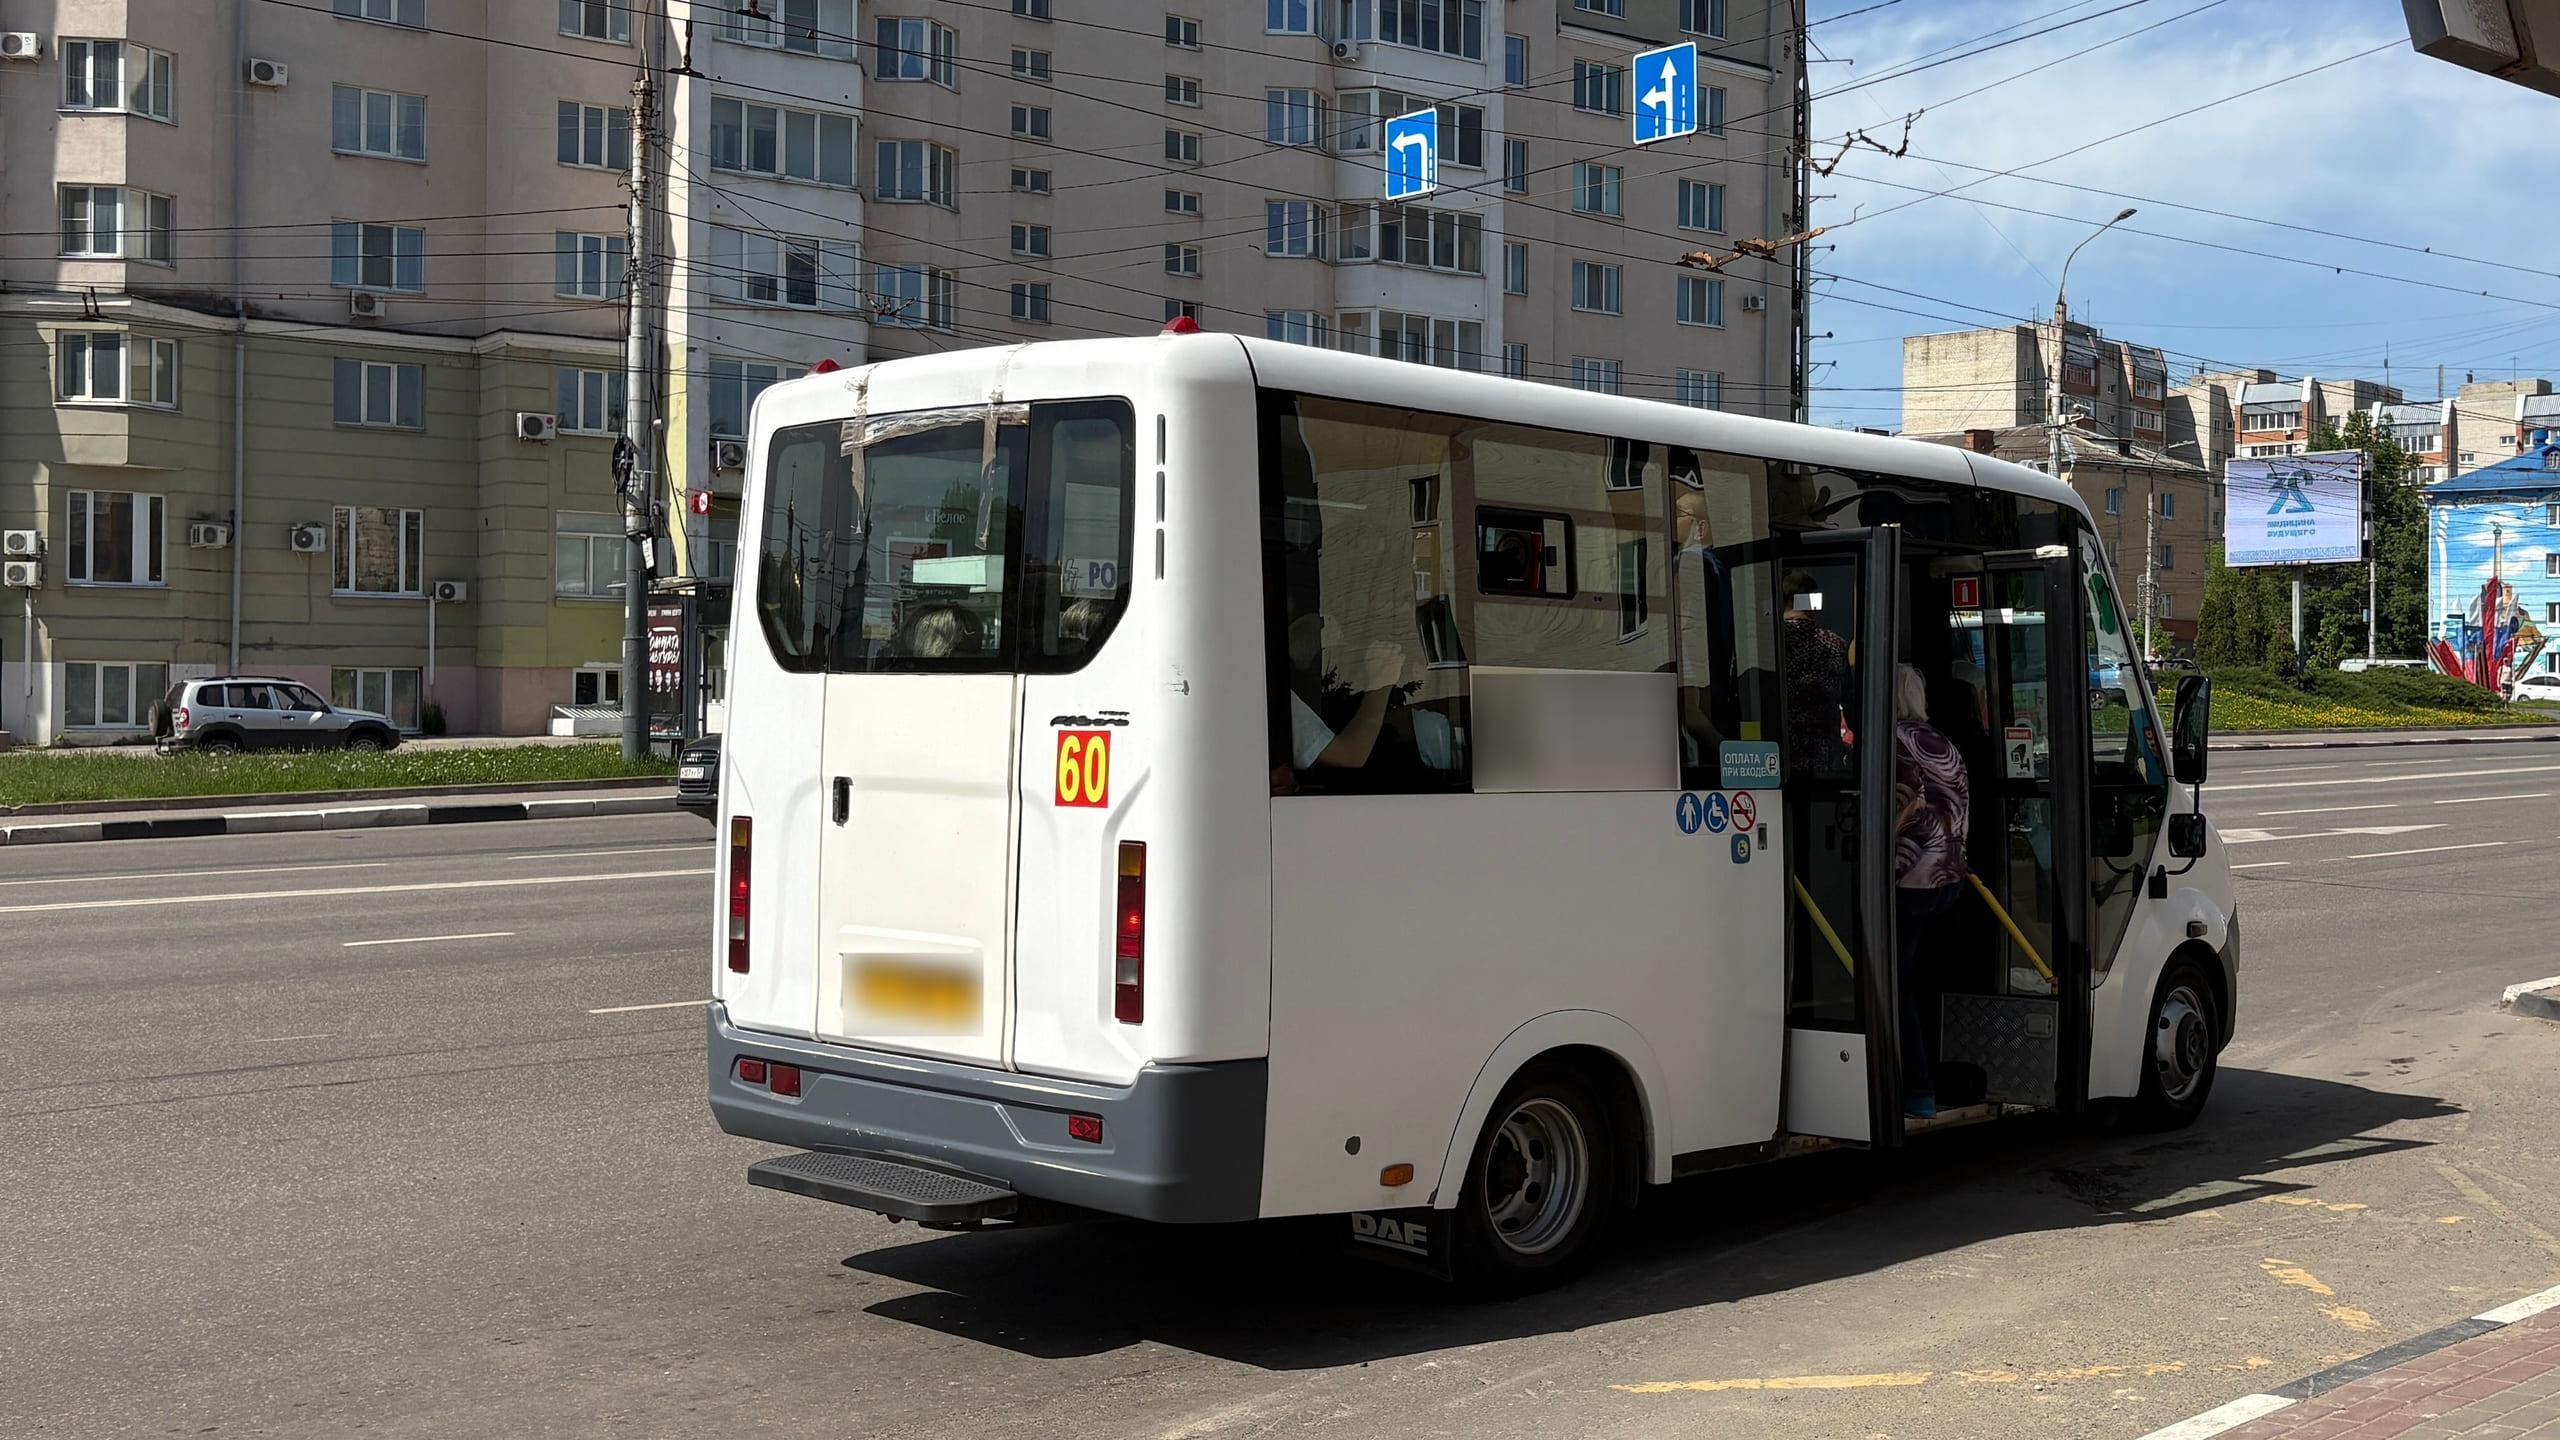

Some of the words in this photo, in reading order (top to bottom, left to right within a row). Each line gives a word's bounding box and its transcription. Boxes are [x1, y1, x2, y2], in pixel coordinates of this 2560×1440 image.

[1058, 734, 1107, 803] 60
[1724, 753, 1761, 764] ОПЛАТА
[1722, 767, 1739, 777] ПРИ
[1740, 767, 1766, 778] ВХОДЕ
[1351, 1212, 1427, 1245] DAF
